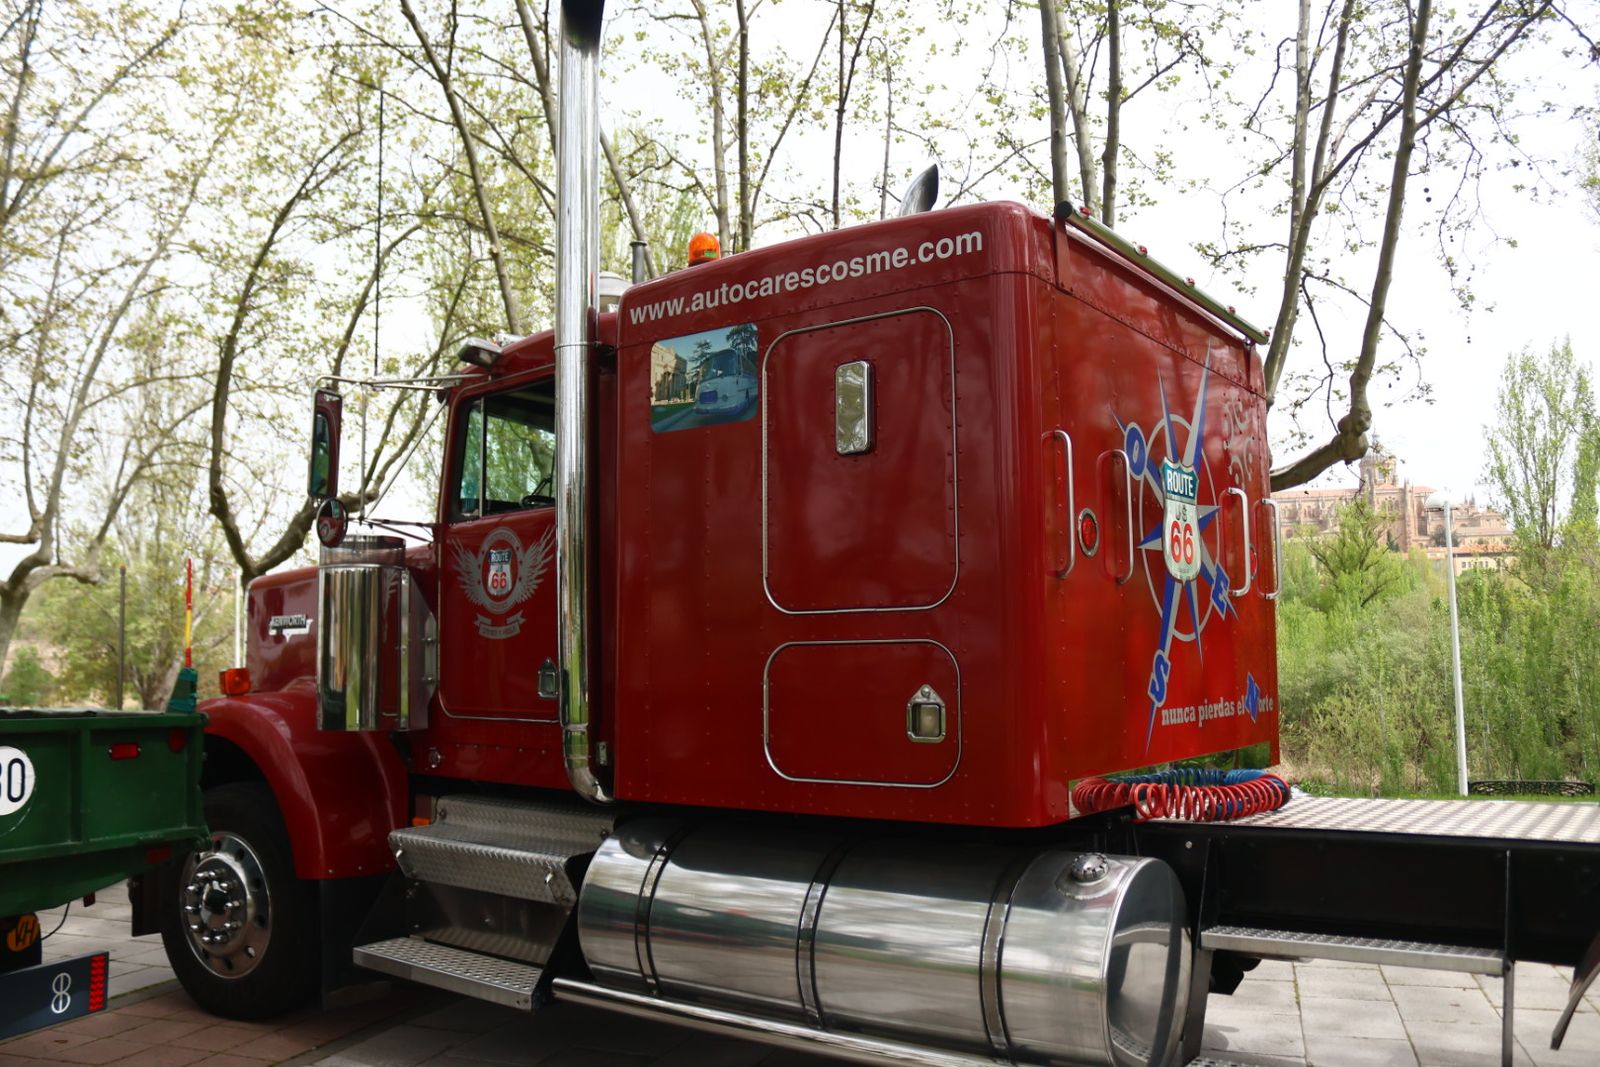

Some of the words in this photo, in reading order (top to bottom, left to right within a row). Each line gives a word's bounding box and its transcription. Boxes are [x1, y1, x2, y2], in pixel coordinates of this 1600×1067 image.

[629, 230, 983, 326] www.autocarescosme.com
[1167, 469, 1194, 497] ROUTE
[490, 551, 509, 562] ROUTE
[1170, 520, 1194, 564] 66
[492, 572, 507, 589] 66
[1161, 705, 1196, 726] nunca
[1198, 697, 1235, 728] pierdas
[1237, 695, 1245, 714] el
[0, 758, 25, 803] 0
